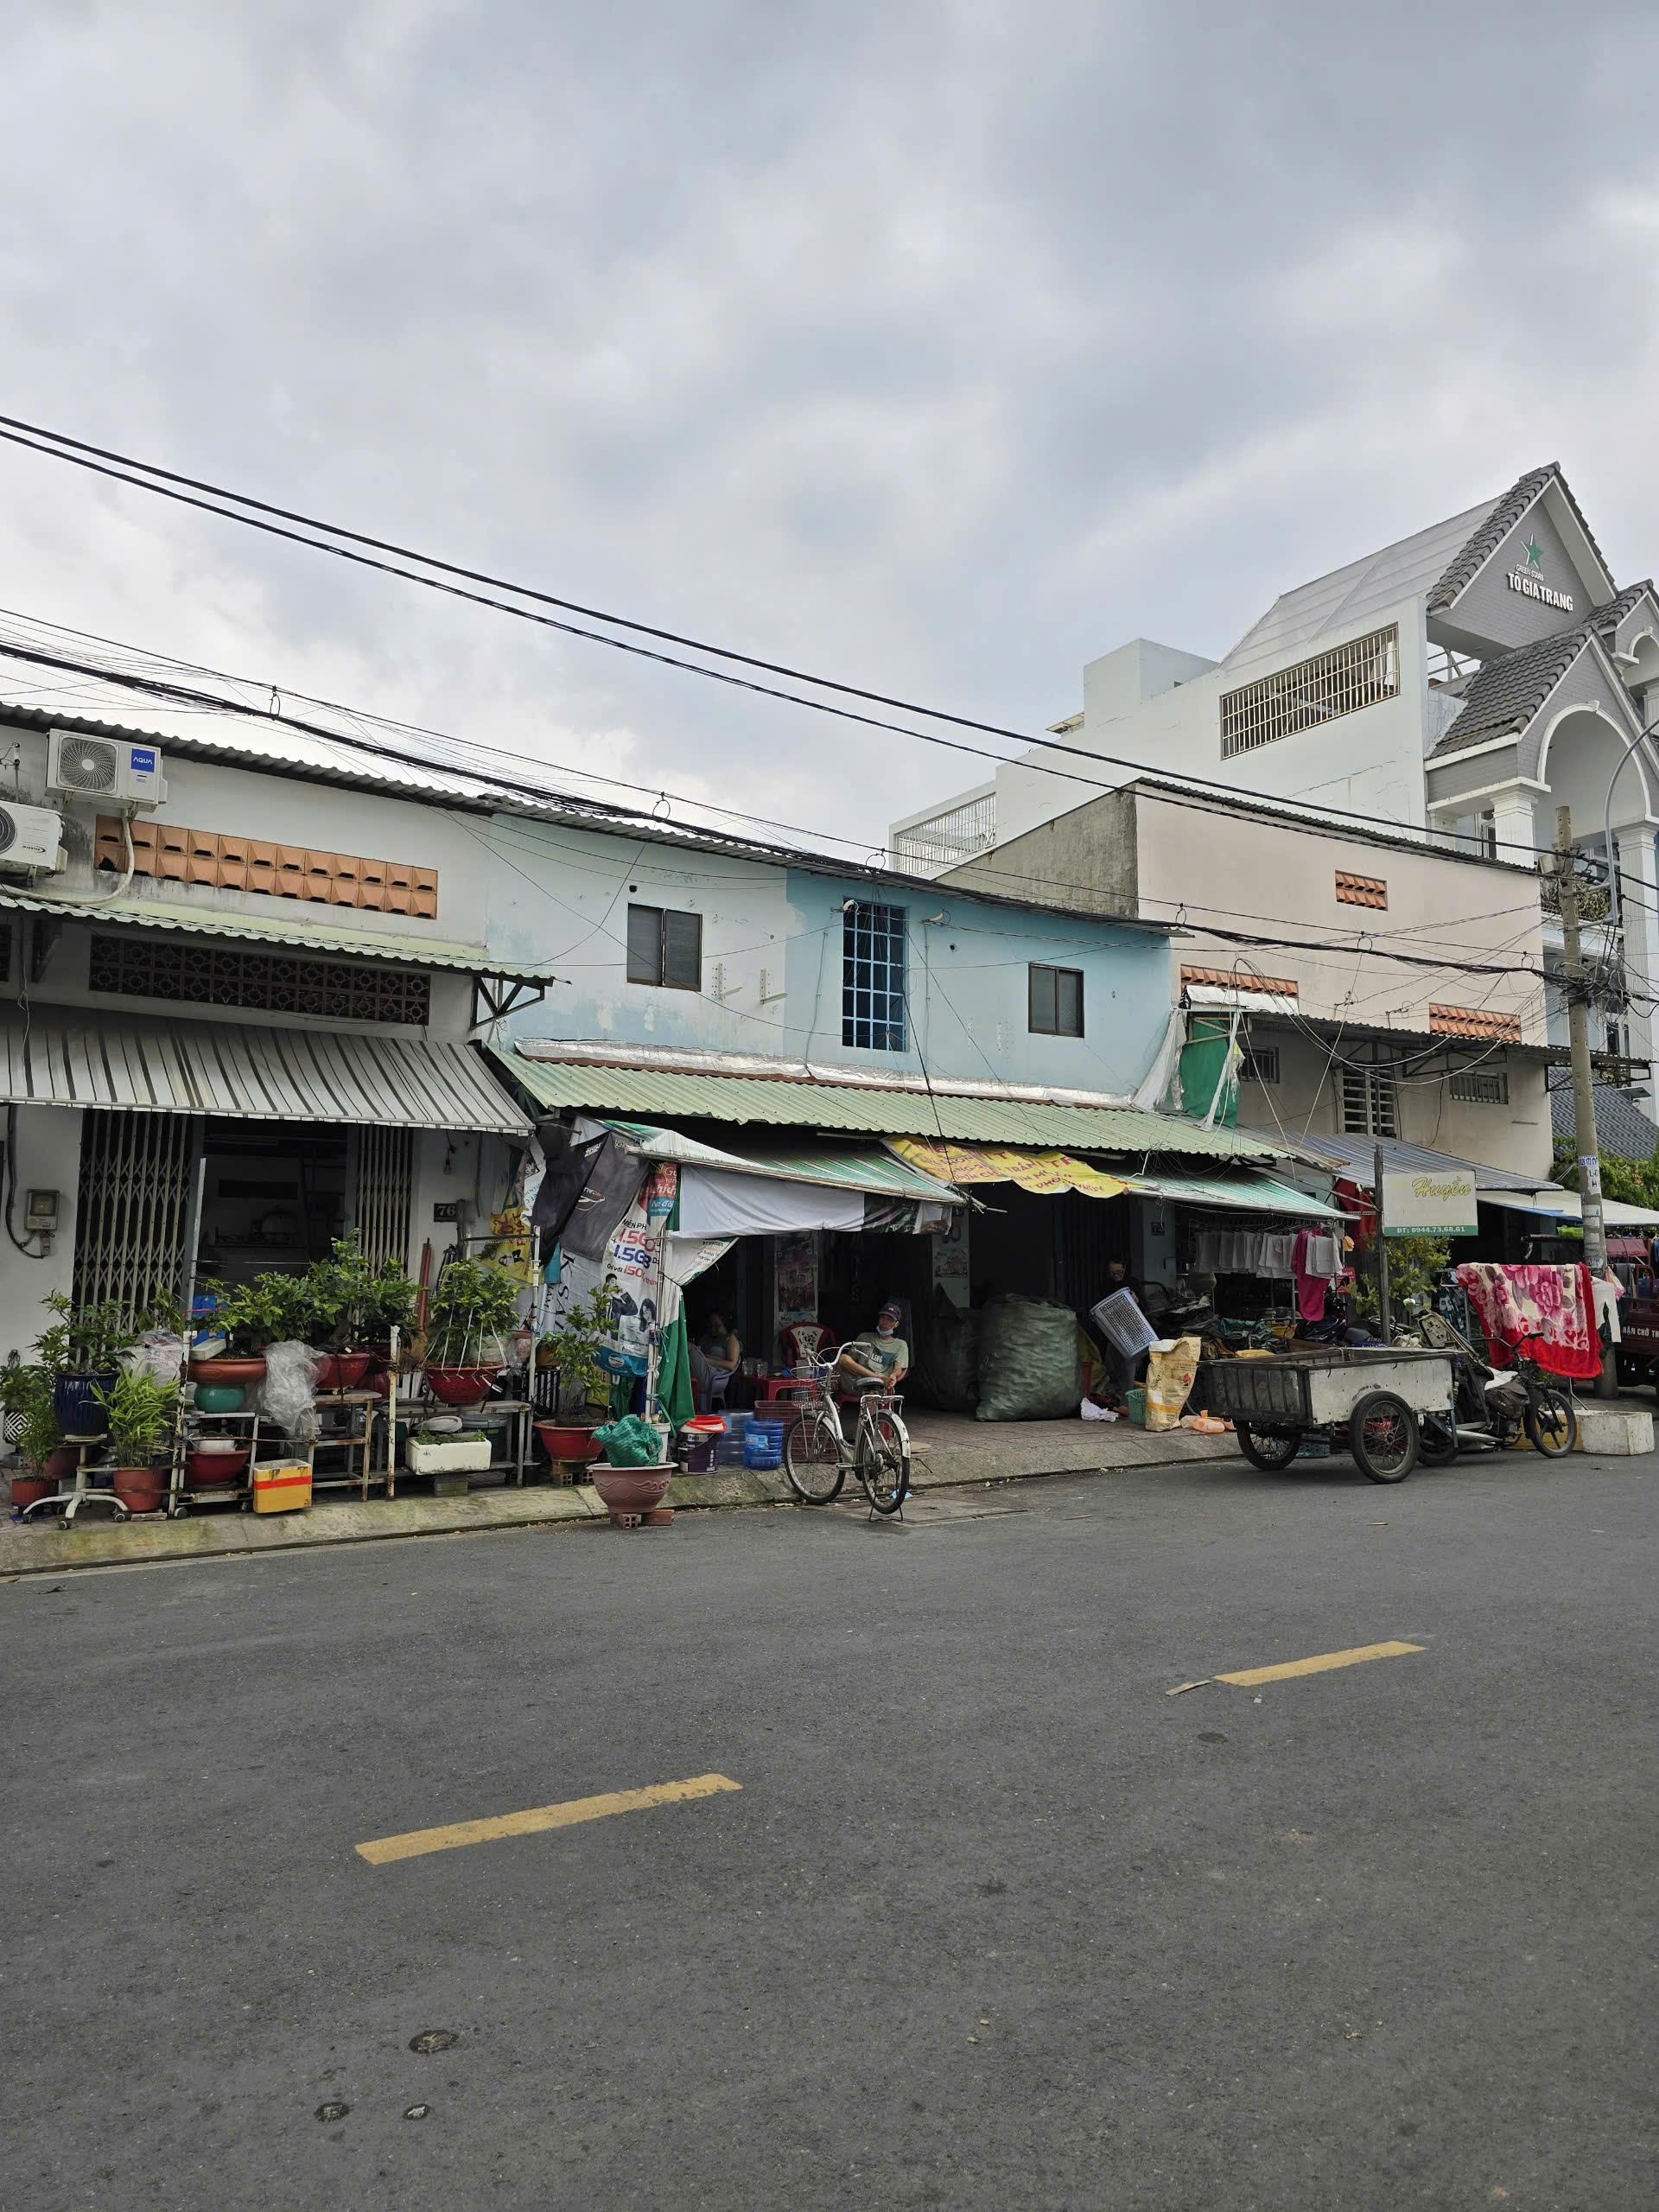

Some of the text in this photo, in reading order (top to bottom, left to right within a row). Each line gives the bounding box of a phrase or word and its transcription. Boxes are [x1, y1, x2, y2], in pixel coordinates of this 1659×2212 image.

[1508, 571, 1573, 611] TÔ GIA TRANG
[1412, 1176, 1471, 1202] Huyền
[436, 1206, 456, 1217] 76
